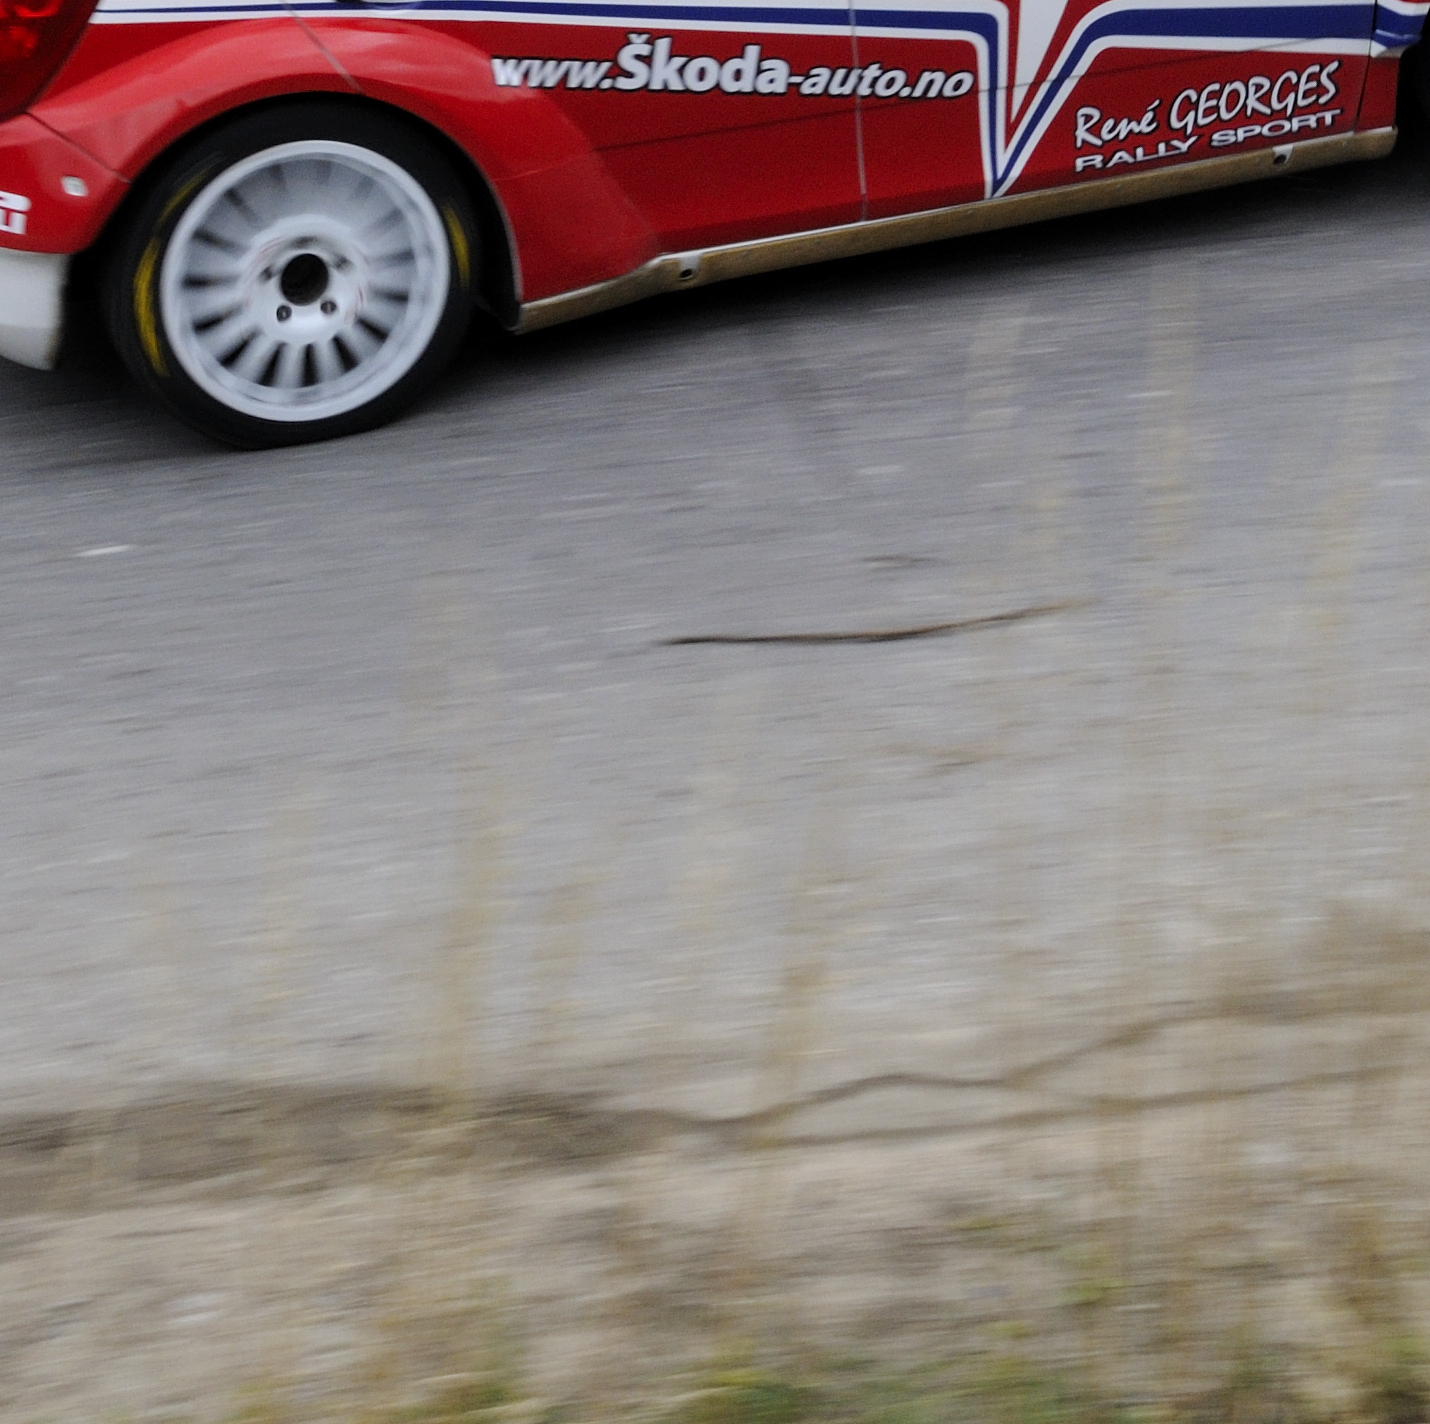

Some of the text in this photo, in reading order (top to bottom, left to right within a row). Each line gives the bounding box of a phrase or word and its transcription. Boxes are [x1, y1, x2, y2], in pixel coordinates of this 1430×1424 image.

[490, 32, 975, 99] www.Škoda-auto.no
[1074, 60, 1341, 149] René GEORGES
[1074, 108, 1342, 172] RALLY SPORT
